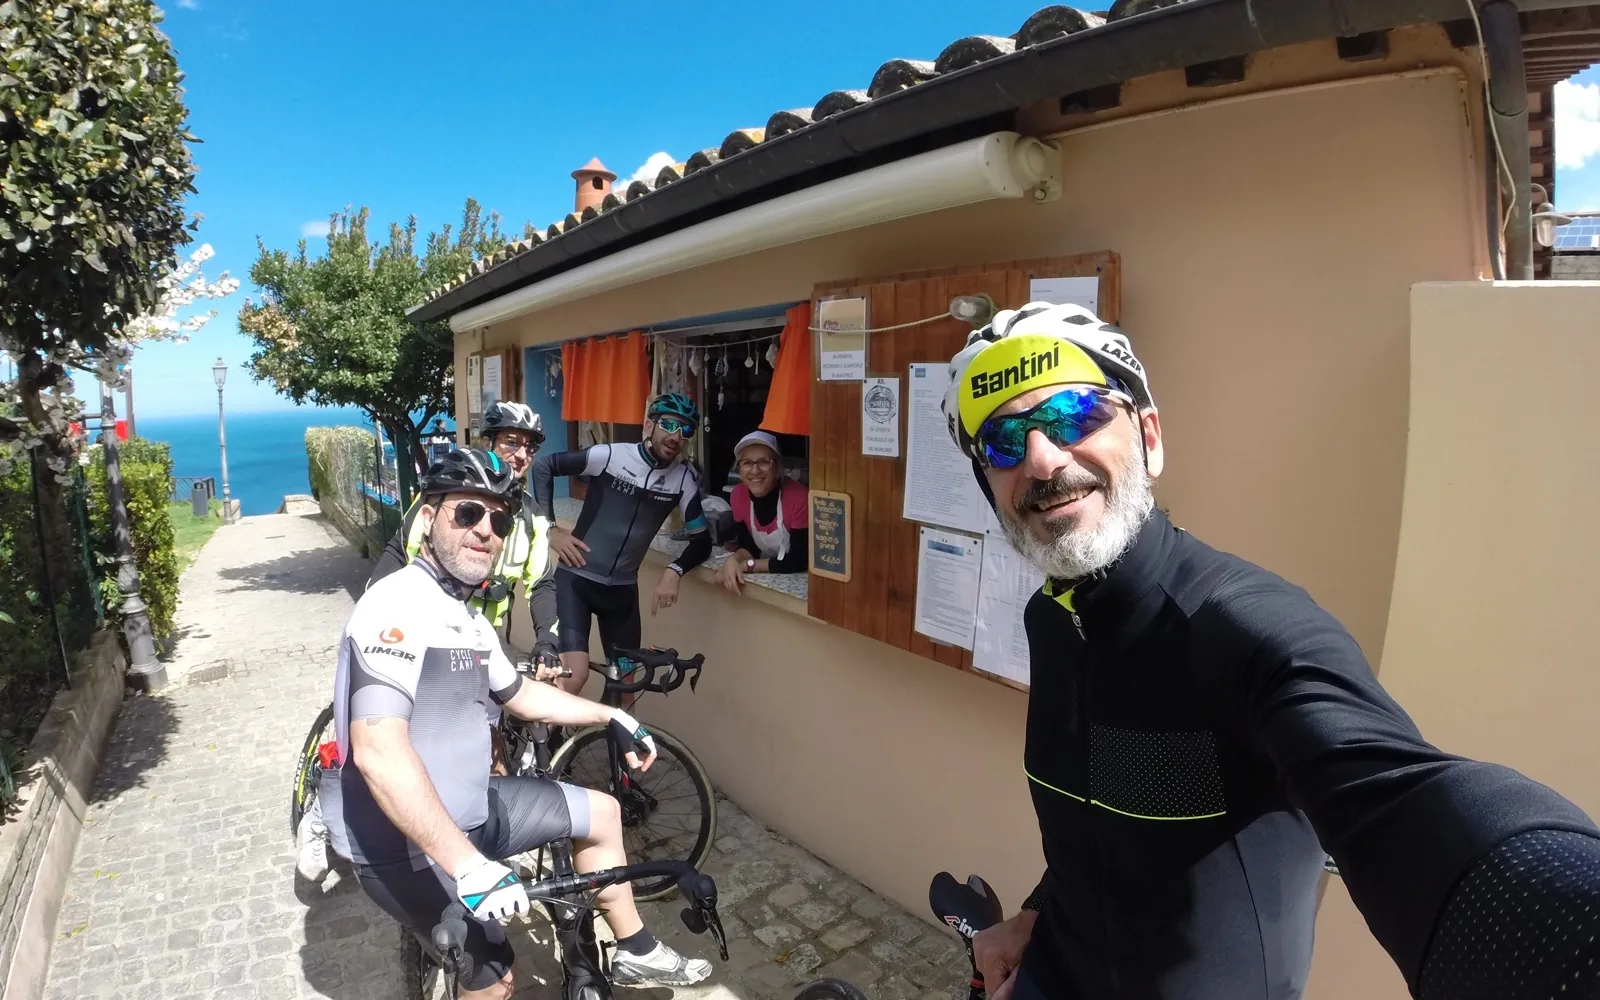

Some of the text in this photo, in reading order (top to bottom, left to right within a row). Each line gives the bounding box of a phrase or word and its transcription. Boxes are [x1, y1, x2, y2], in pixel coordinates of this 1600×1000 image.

[1100, 343, 1142, 375] LAZER
[971, 342, 1060, 399] Santini
[611, 482, 635, 496] CAMP
[613, 477, 637, 490] CYCLE
[450, 649, 472, 660] CYCLE
[451, 660, 473, 672] CAMP
